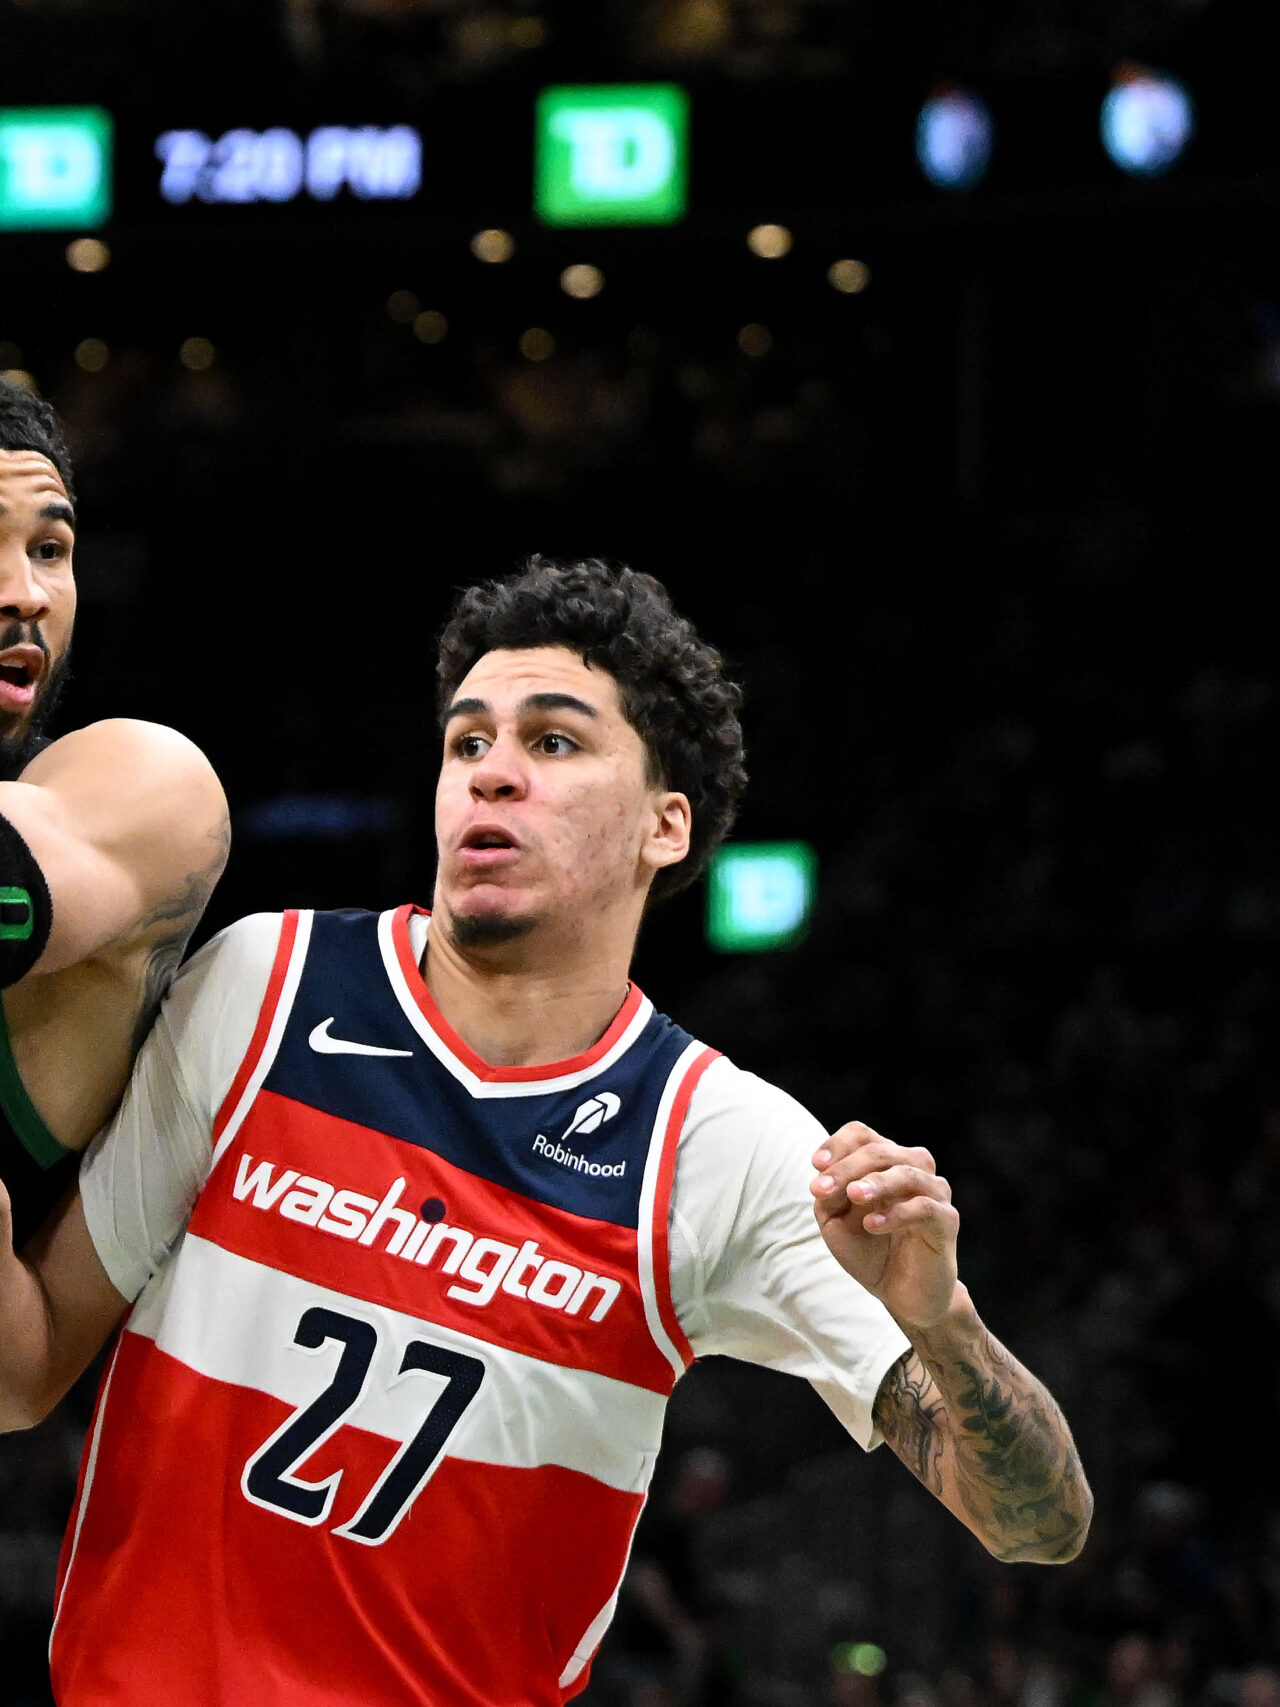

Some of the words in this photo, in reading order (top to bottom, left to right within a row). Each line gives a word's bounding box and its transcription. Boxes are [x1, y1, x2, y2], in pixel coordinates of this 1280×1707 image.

[305, 125, 422, 199] PM
[531, 1133, 627, 1178] Robinhood
[231, 1153, 622, 1324] washington
[240, 1305, 487, 1547] 27
